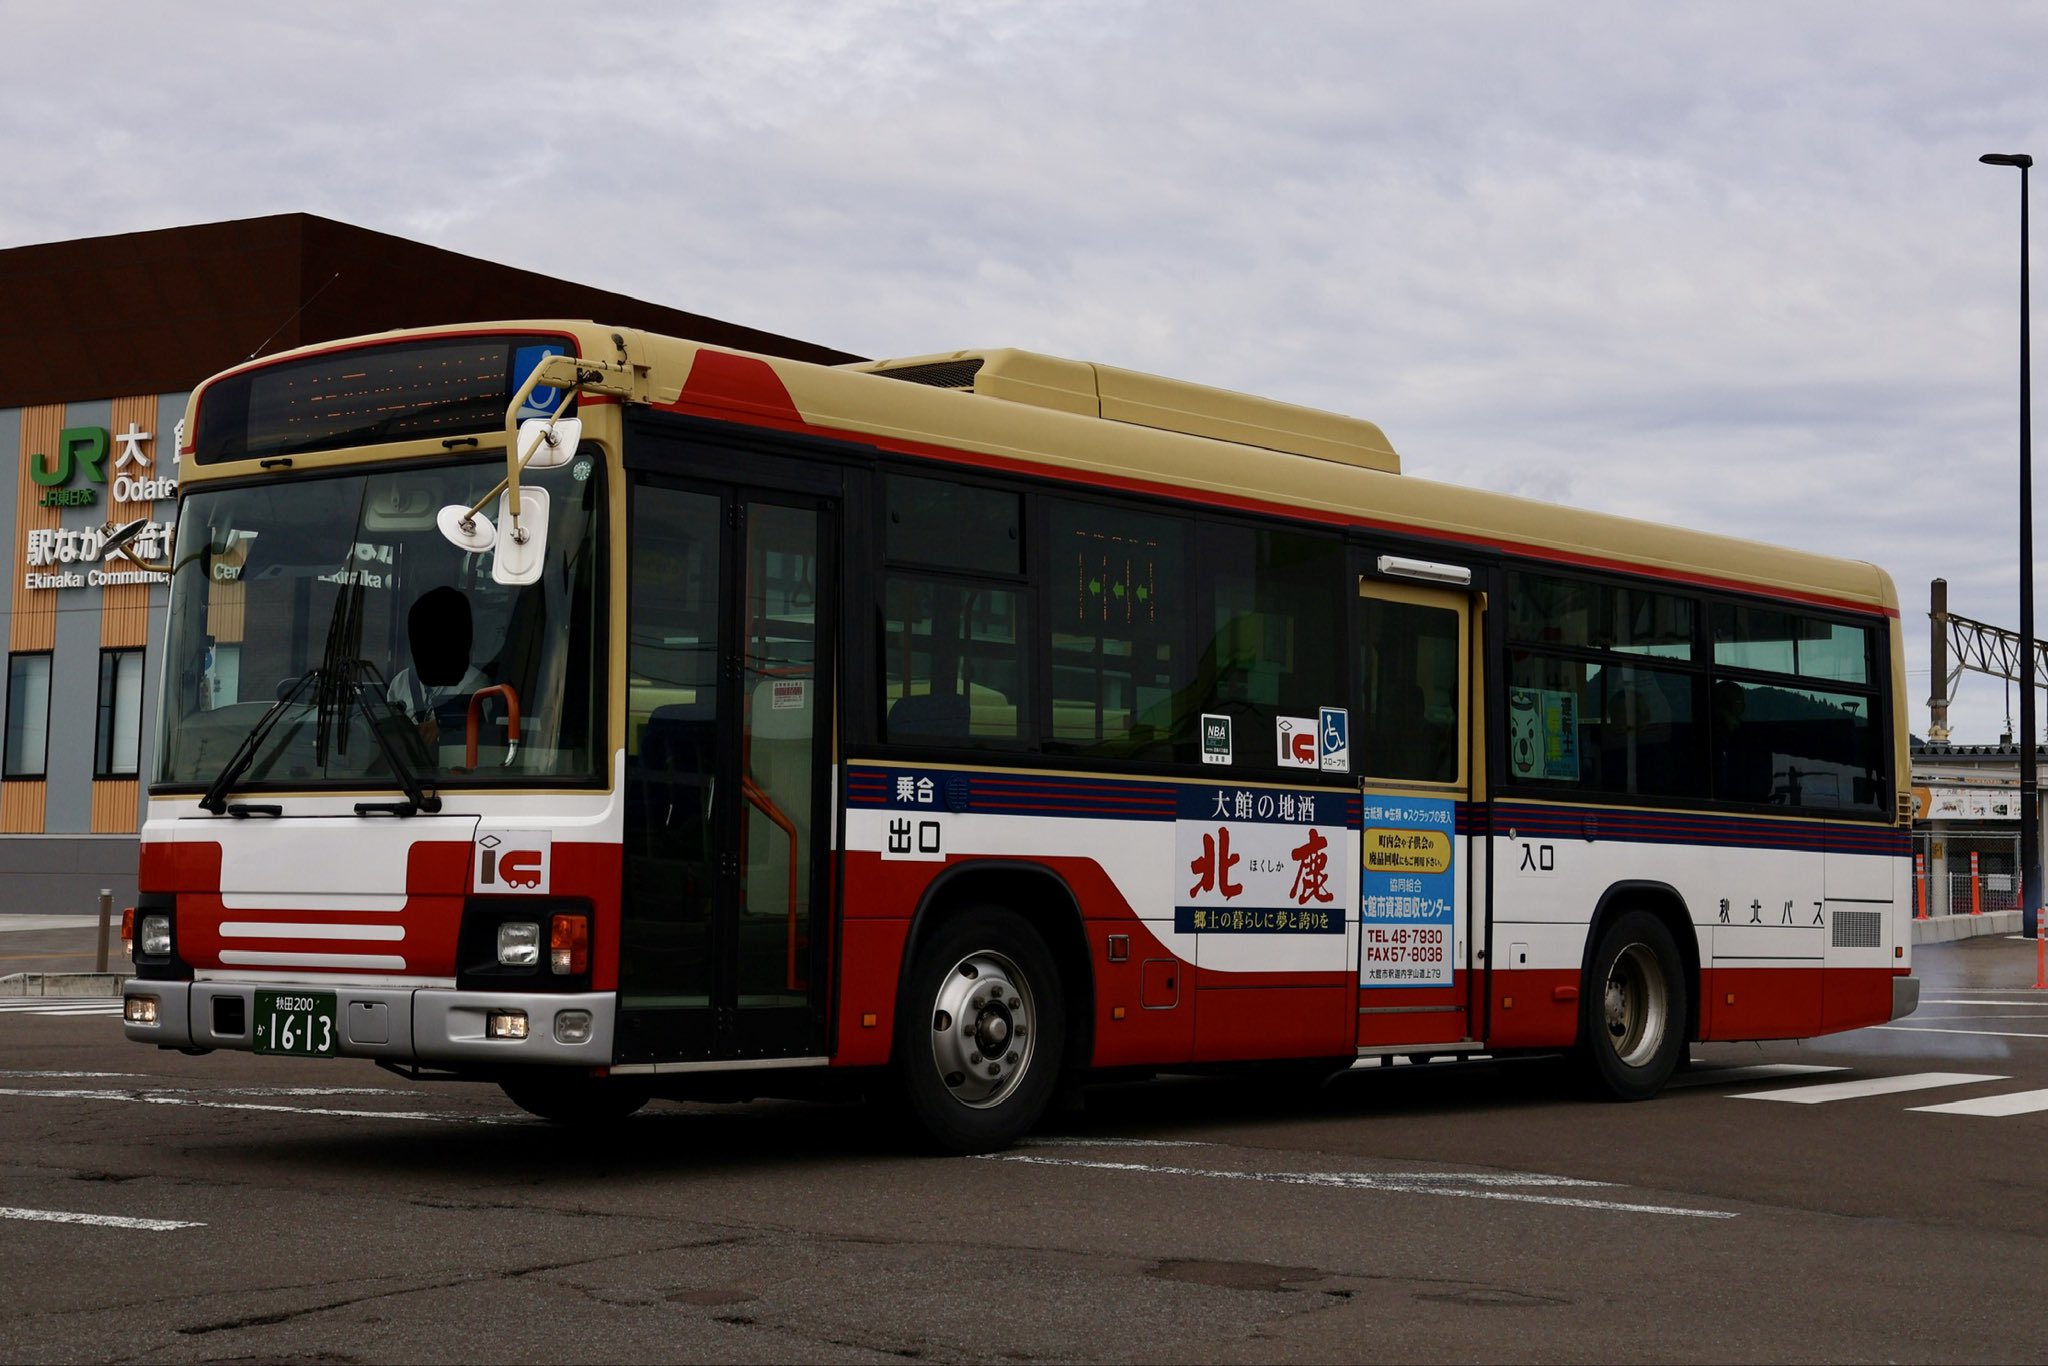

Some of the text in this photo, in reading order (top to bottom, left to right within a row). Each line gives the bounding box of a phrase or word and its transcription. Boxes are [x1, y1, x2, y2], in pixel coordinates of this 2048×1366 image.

[31, 427, 108, 487] JR
[40, 489, 96, 507] JR東日本
[25, 571, 85, 590] Ekinaka
[1207, 725, 1226, 738] NBA
[897, 776, 934, 803] 乗合
[1211, 790, 1315, 822] 大館の地酒
[888, 817, 941, 854] 出口
[1379, 834, 1434, 850] 町内会や子供会の
[1520, 843, 1554, 871] 入口
[1249, 860, 1285, 873] ほくしか
[1389, 878, 1422, 893] 協同組合
[1194, 909, 1328, 930] 郷土の暮らしに夢と誇りを
[1719, 898, 1824, 925] 秋北バス
[1368, 929, 1442, 944] TEL 48-7930
[1367, 947, 1443, 962] FAX 57-8036
[256, 1024, 266, 1037] か
